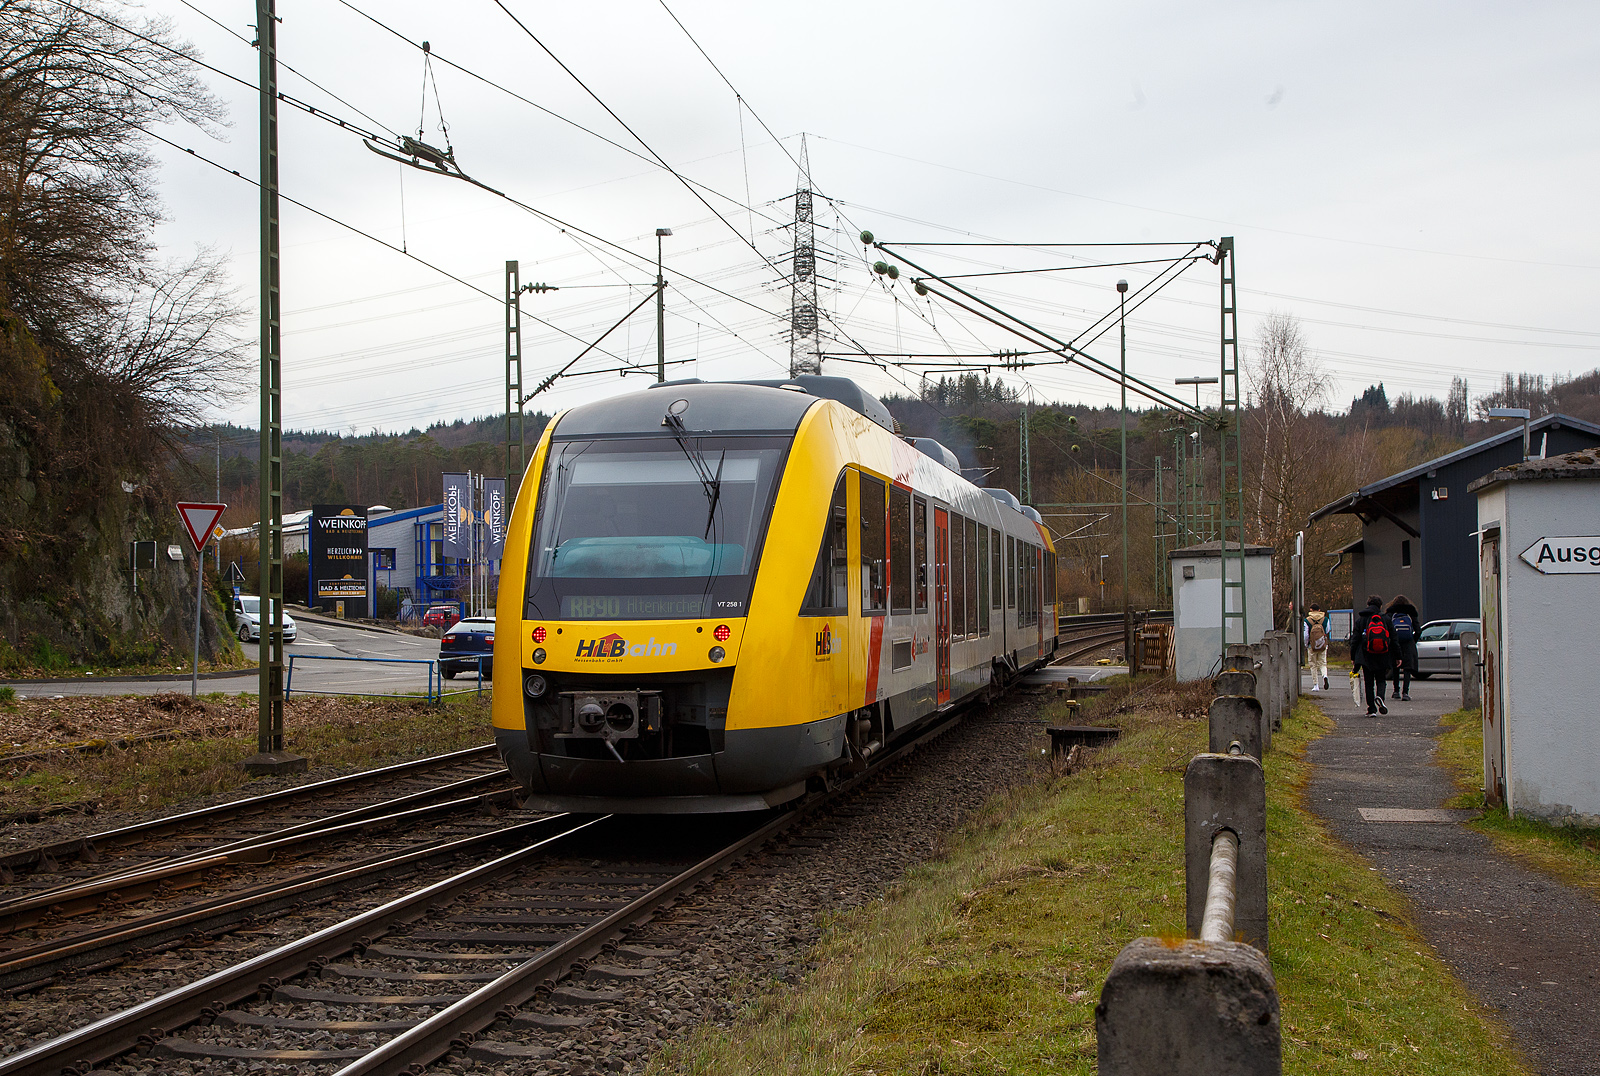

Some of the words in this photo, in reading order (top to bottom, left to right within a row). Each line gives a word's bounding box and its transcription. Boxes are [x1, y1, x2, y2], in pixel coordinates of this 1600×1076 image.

[318, 519, 367, 529] WEINKOPF
[492, 489, 501, 545] WEINKOPF
[327, 547, 353, 555] HERZLICH
[1537, 543, 1600, 566] Ausg
[570, 596, 620, 617] RB90
[627, 596, 705, 614] Altenkirchen
